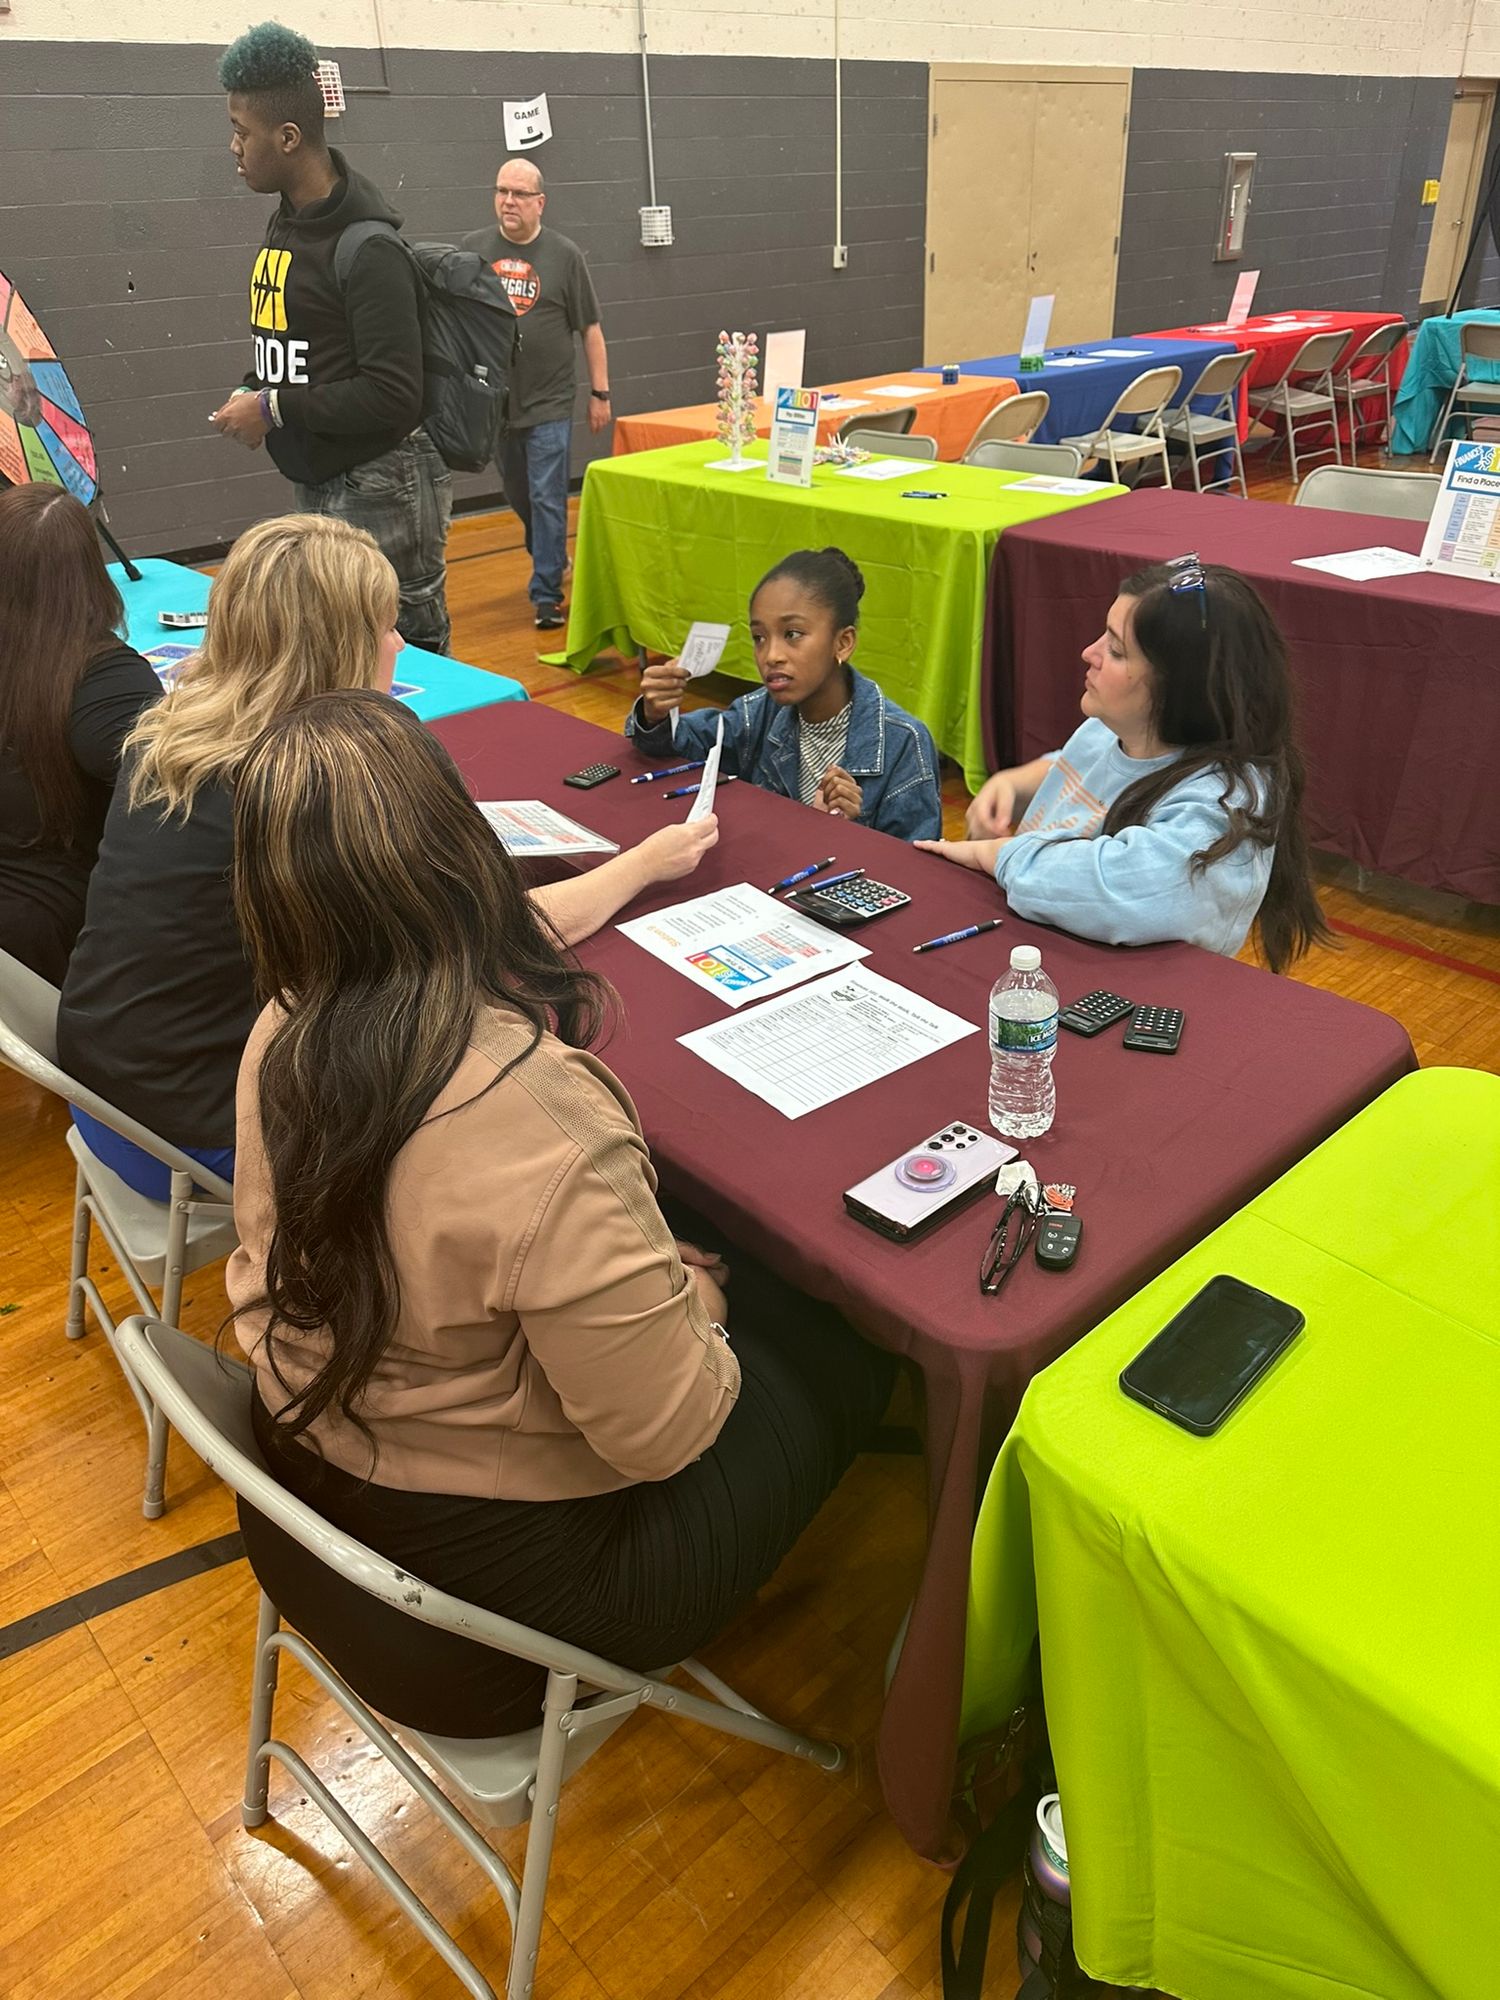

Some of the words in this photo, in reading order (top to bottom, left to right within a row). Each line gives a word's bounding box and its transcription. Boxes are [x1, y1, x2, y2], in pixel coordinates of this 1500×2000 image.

[514, 106, 540, 120] GAME
[527, 126, 534, 134] B
[251, 334, 309, 383] ODE
[1457, 475, 1473, 484] Find
